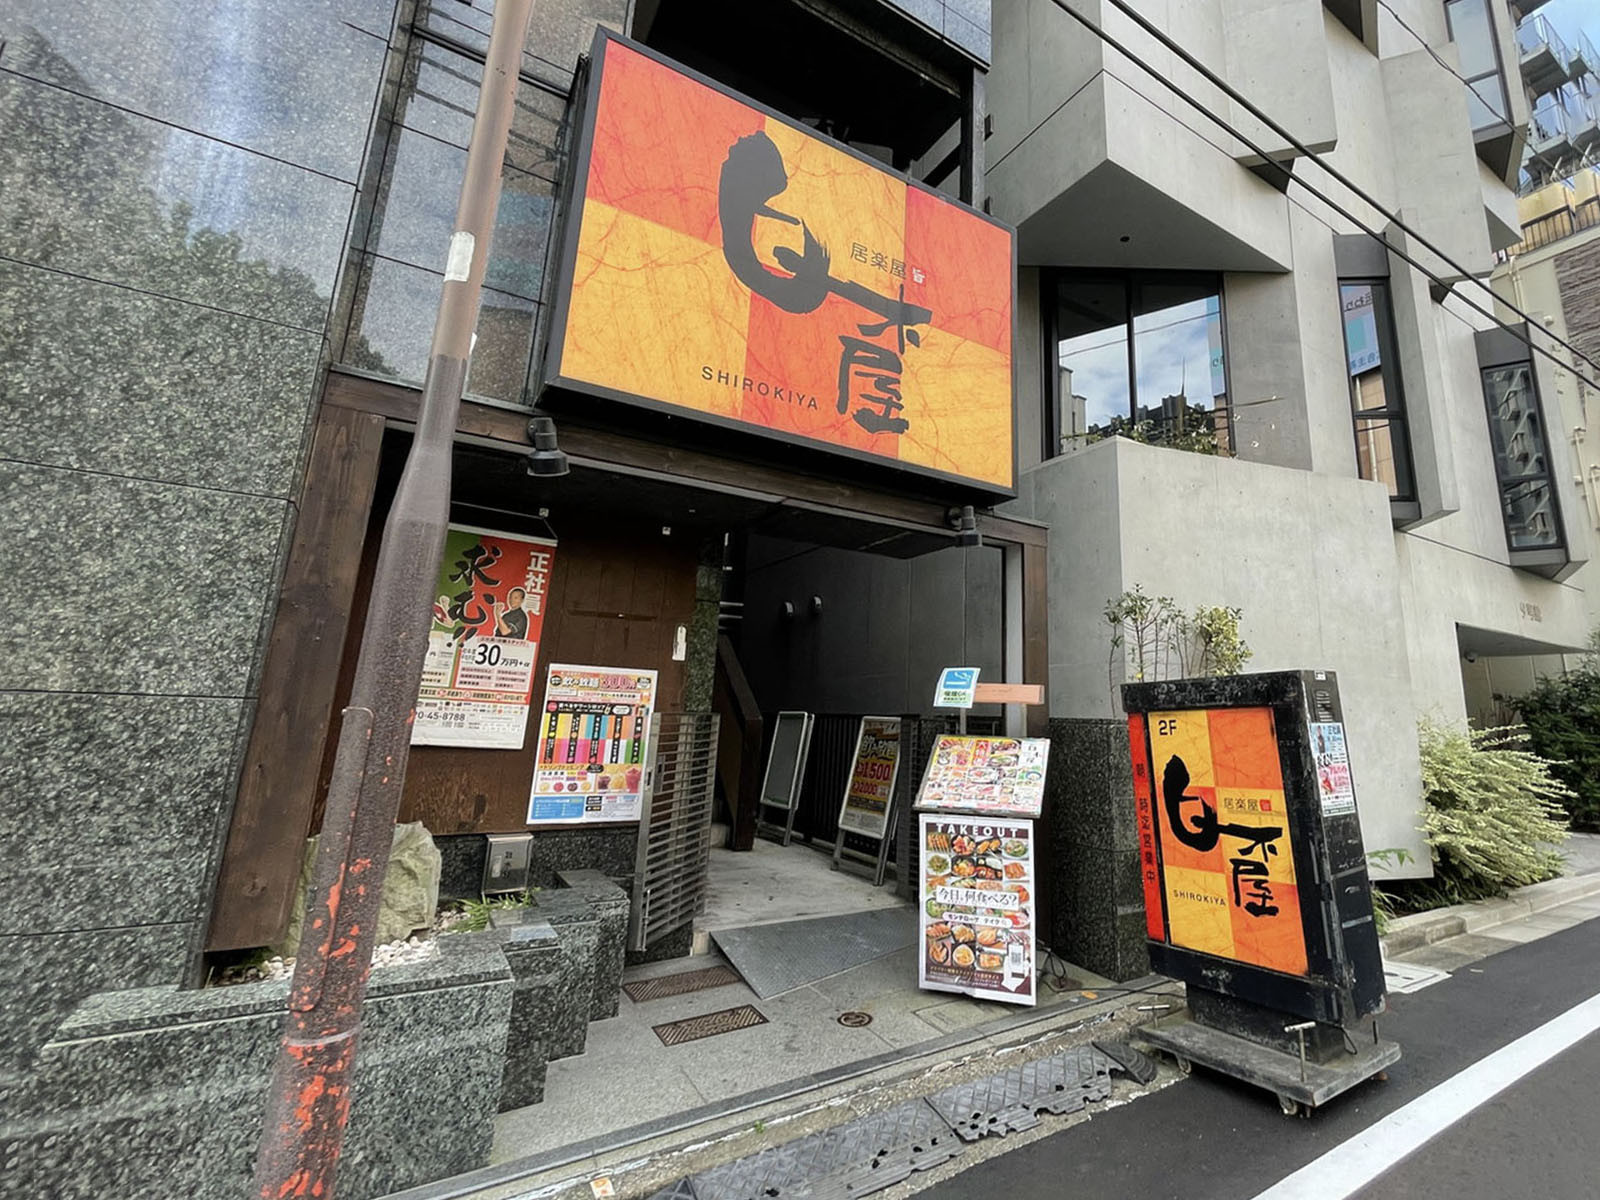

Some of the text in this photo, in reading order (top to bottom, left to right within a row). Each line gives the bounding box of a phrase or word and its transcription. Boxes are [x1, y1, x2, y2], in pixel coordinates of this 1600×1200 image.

[849, 241, 907, 280] 居楽屋
[718, 129, 933, 434] 白木屋
[701, 365, 819, 412] SHIROKIYA
[524, 550, 551, 616] 正社員
[1158, 719, 1177, 736] 2F
[1224, 796, 1259, 812] 居楽屋
[936, 822, 1019, 838] TAKEOUT
[1162, 754, 1284, 918] 白木屋
[1172, 888, 1227, 908] SHIROKIYA
